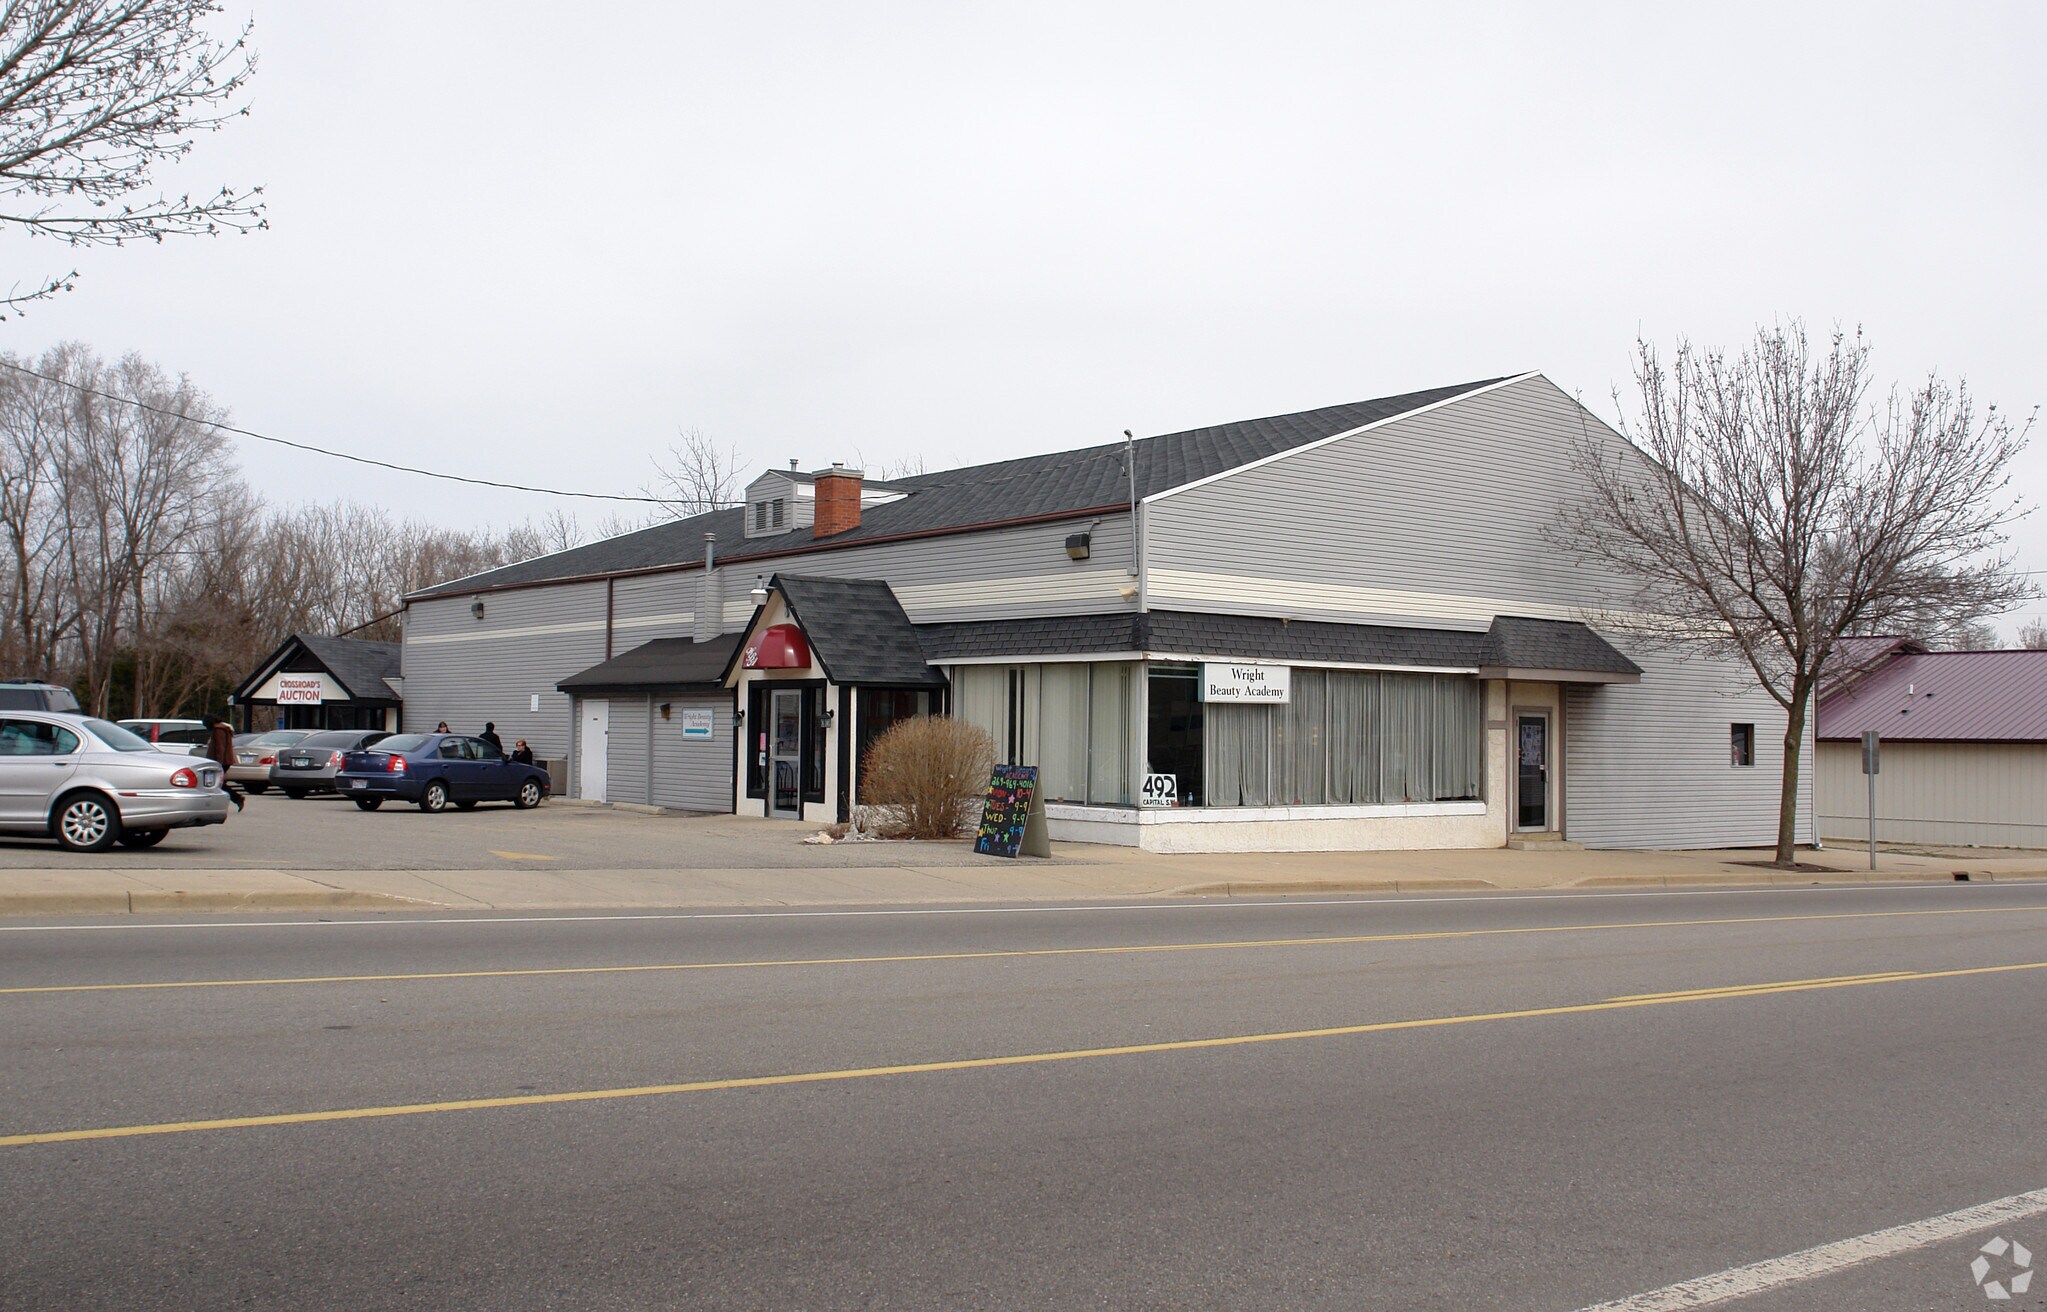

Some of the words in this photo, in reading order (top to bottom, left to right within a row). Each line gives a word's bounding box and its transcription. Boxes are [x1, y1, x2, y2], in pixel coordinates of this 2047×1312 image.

[1231, 668, 1265, 683] Wright
[280, 680, 321, 688] CROSSROAD'S
[1209, 684, 1241, 698] Beauty
[1244, 685, 1284, 699] Academy
[279, 690, 320, 700] AUCTION
[1142, 776, 1176, 798] 492
